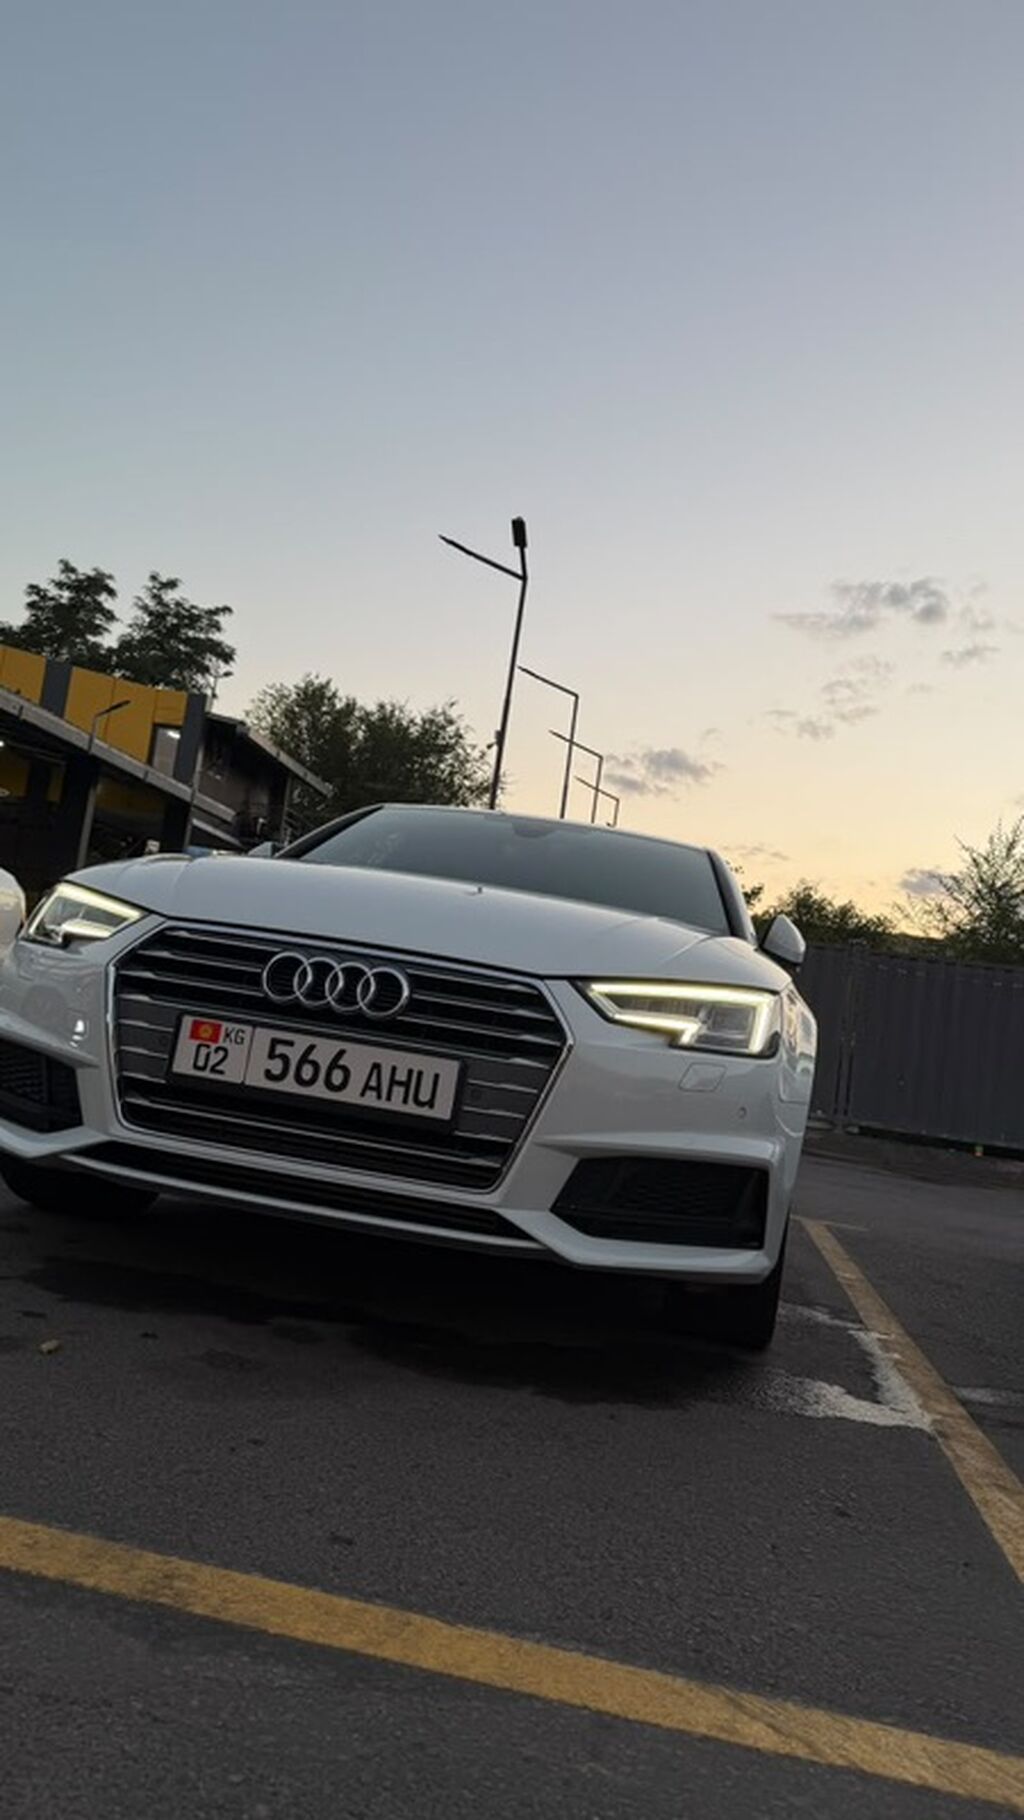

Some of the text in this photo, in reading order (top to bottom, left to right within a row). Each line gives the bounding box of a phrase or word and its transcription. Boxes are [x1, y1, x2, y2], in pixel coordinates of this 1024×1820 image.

[223, 1026, 246, 1046] KG
[192, 1043, 229, 1075] 02
[263, 1037, 441, 1110] 566 AHU
